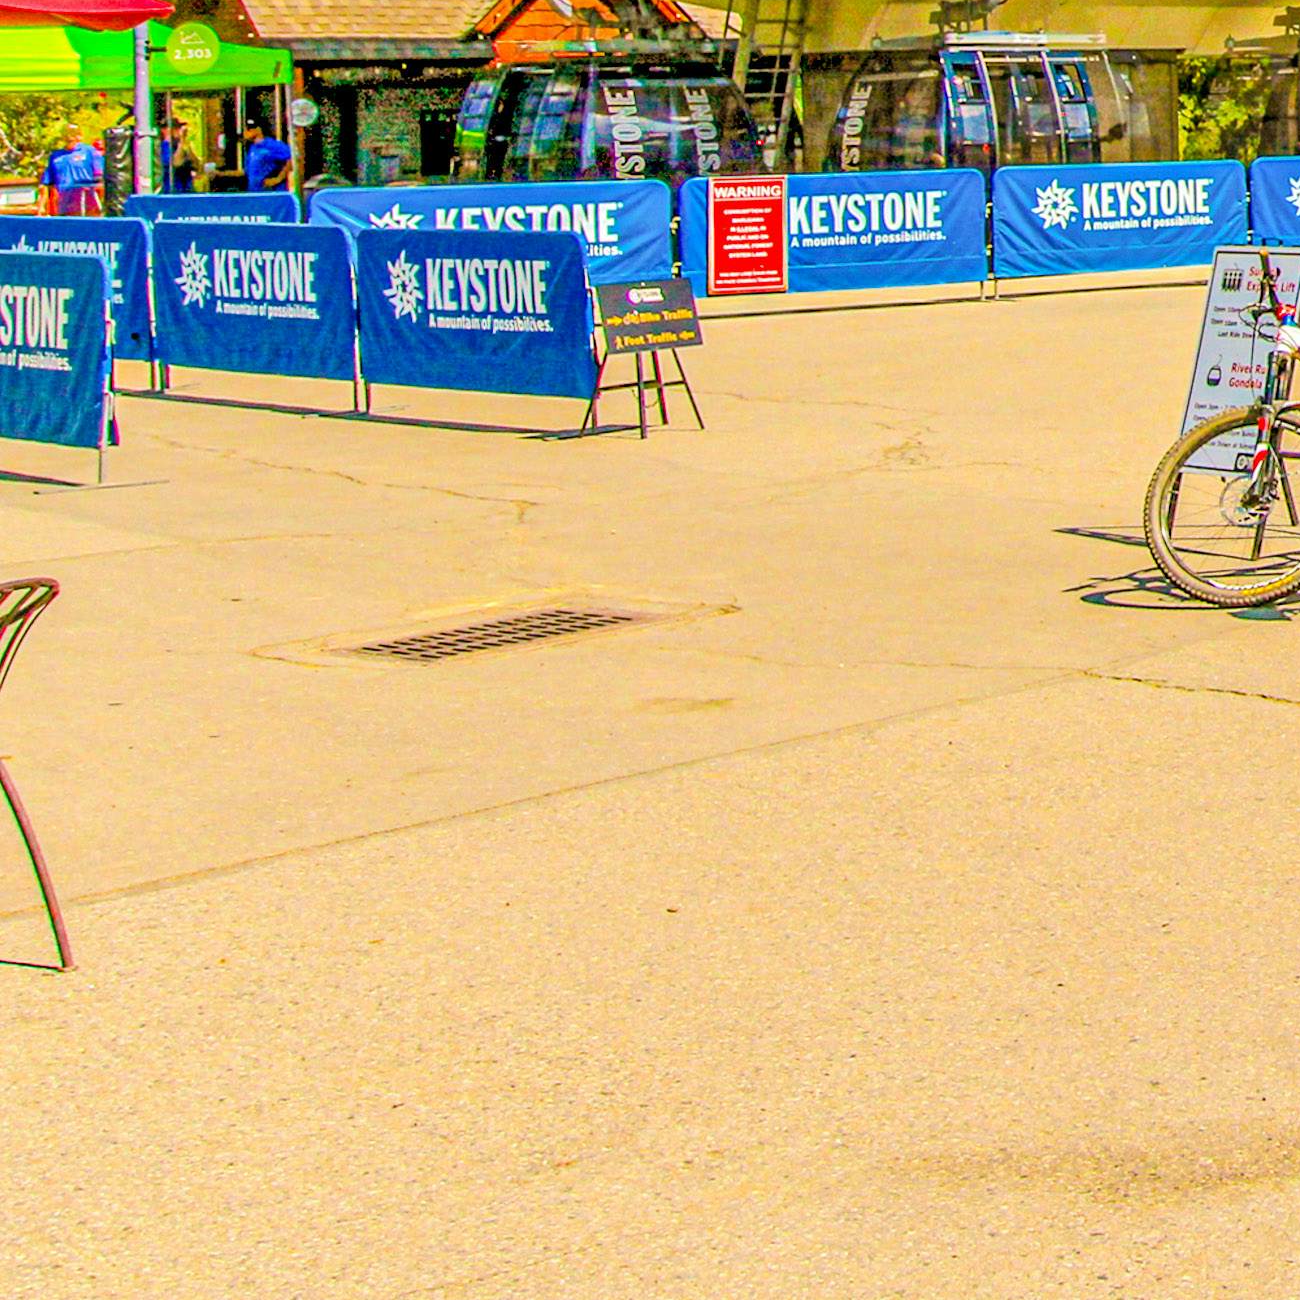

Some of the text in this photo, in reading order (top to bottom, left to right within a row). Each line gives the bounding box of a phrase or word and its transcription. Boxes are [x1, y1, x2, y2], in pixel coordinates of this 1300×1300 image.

[714, 185, 782, 198] WARNING
[1082, 178, 1210, 219] KEYSTONE
[789, 190, 942, 235] KEYSTONE
[1083, 215, 1213, 231] A mountain of possibilities.
[791, 229, 947, 248] A mountain of possibilities.
[213, 249, 317, 301] KEYSTONE
[425, 258, 547, 314] KEYSTONE
[1281, 283, 1296, 293] Lift
[0, 284, 69, 350] STONE
[216, 300, 320, 320] A mountain of possibilities.
[429, 315, 553, 334] A mountain of possibilities.
[7, 349, 17, 366] of
[18, 351, 72, 371] possibilities.
[1255, 364, 1267, 374] Ru
[1229, 377, 1262, 389] Gondola
